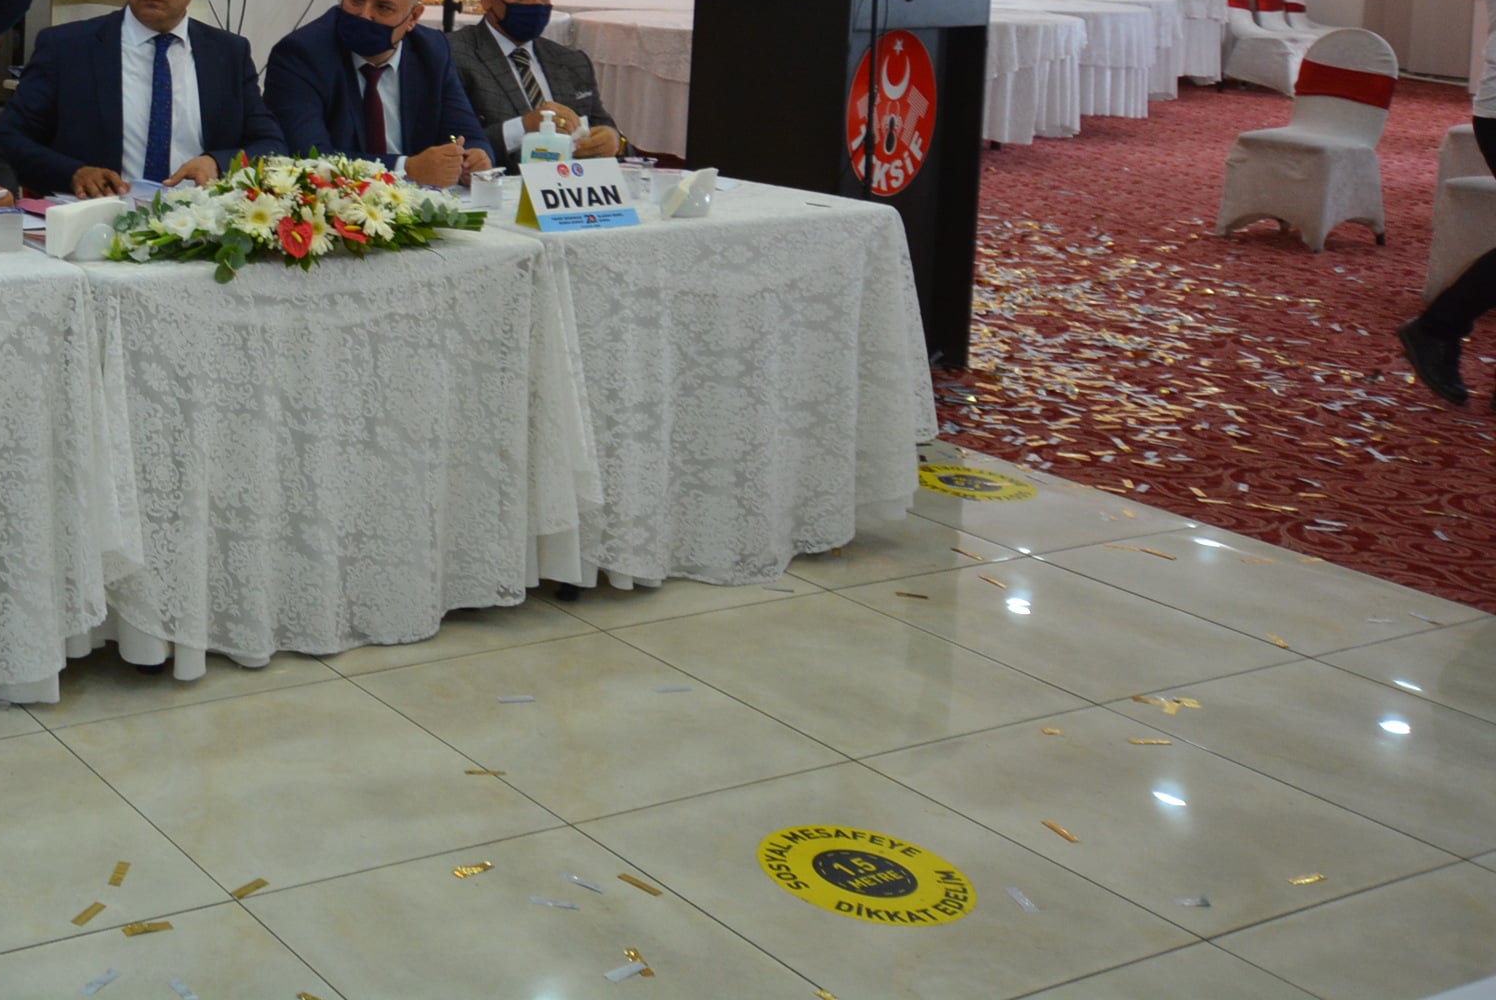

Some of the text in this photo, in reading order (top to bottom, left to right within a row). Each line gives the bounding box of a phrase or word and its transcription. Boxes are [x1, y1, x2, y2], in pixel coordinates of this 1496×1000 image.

[540, 182, 623, 210] DİVAN
[765, 828, 922, 891] SOSYAL MESAFEYE
[833, 857, 877, 877] 1.5
[847, 869, 904, 889] METRE
[835, 869, 968, 924] DİKKAT EDELİM
